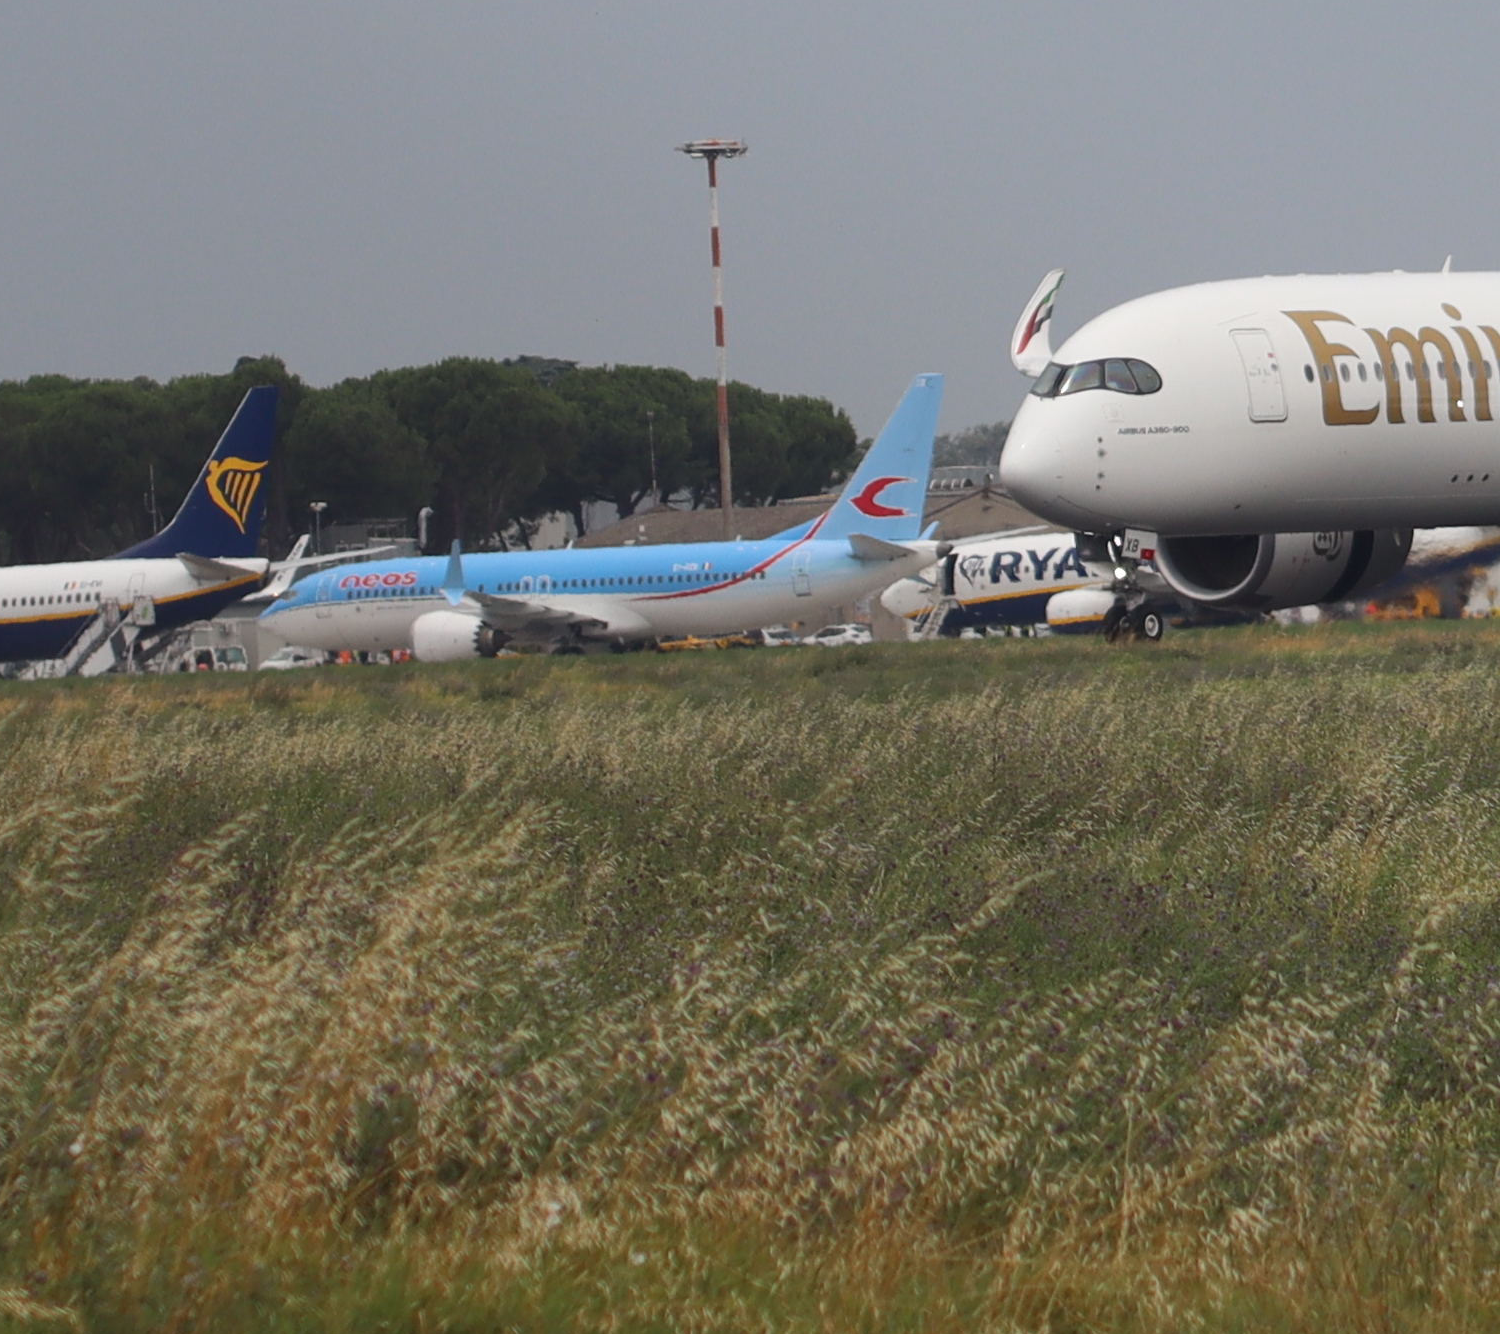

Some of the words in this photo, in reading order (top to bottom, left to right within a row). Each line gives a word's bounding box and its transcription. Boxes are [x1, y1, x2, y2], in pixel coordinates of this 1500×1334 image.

[1117, 427, 1146, 436] AIRBUS
[1124, 537, 1140, 553] XB
[339, 571, 418, 589] neos
